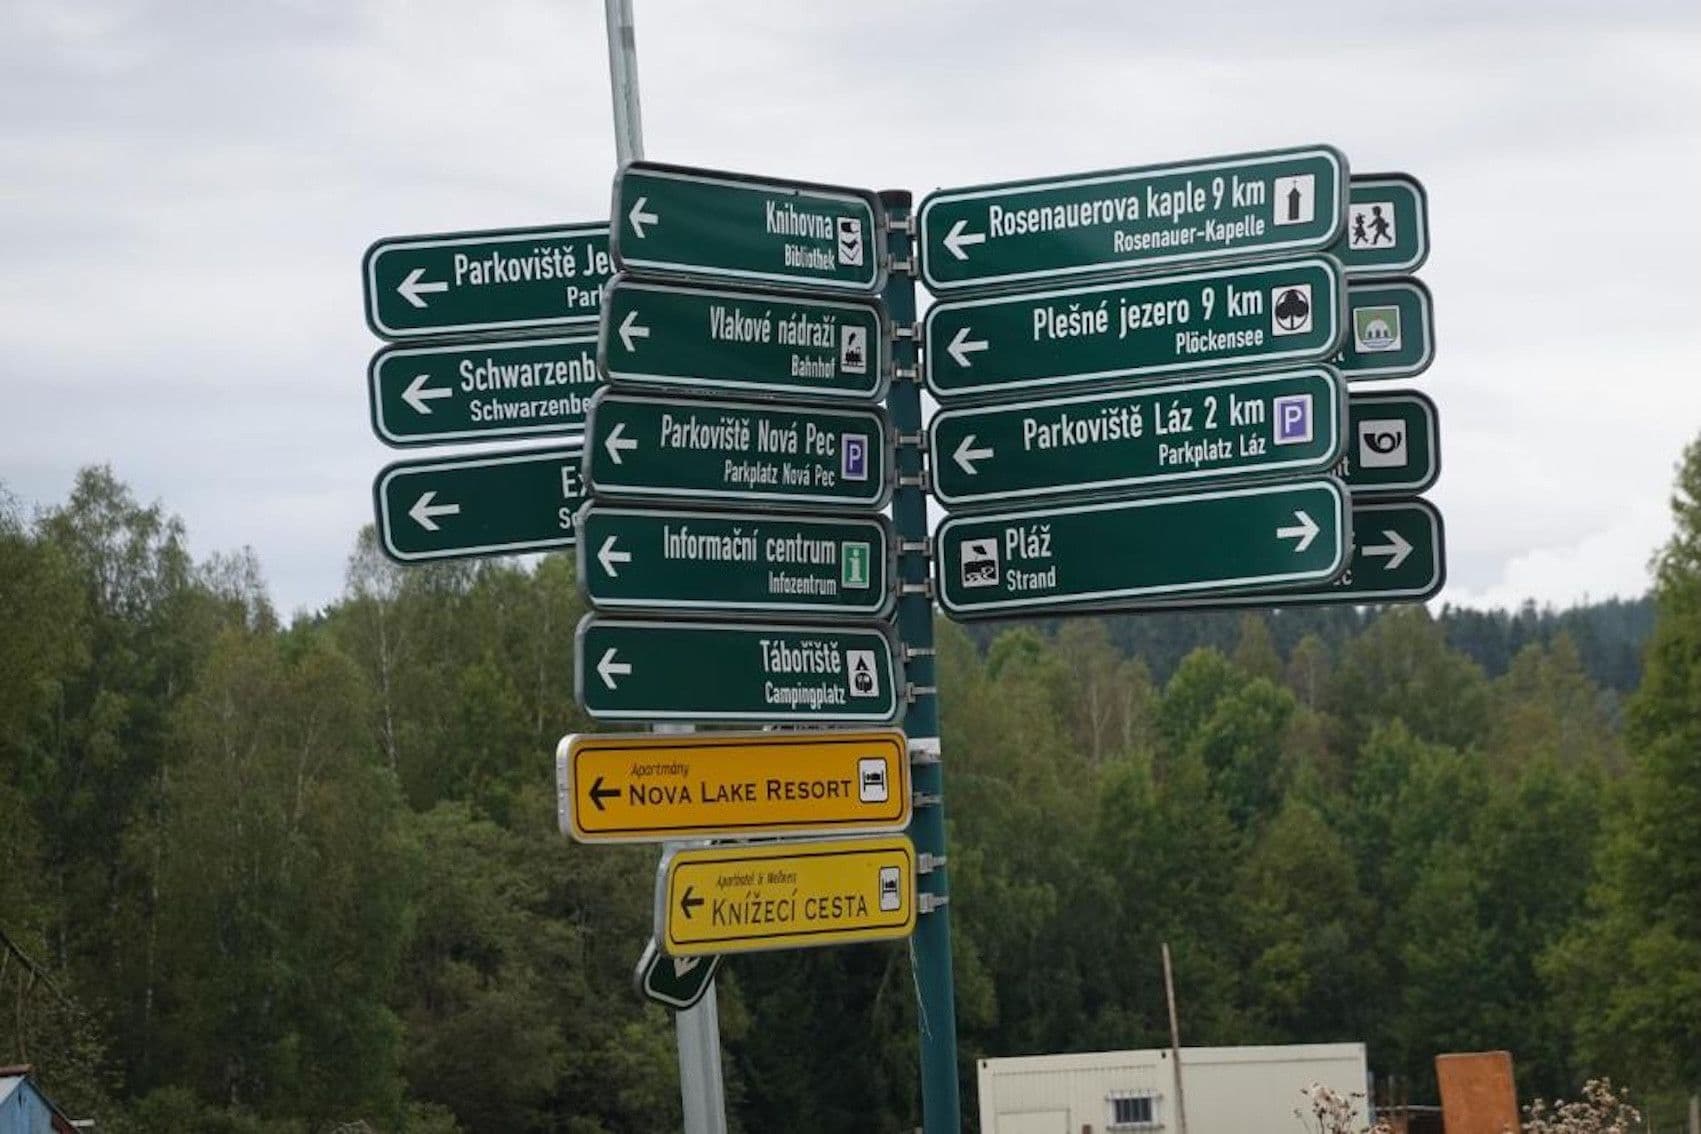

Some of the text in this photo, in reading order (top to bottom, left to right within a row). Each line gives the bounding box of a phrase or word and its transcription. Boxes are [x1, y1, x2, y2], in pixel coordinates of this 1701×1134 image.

[766, 200, 834, 240] Knihovna
[989, 175, 1265, 238] Rosenauerova kaple 9 km
[1114, 215, 1265, 253] Rosenauer-Kapelle
[454, 245, 576, 286] Parkoviště
[784, 244, 836, 270] Bibliothek
[710, 305, 836, 348] Vlakové nádraží
[1033, 284, 1263, 341] Plešné jezero 9 km
[1175, 328, 1264, 355] Plöckensee
[791, 354, 835, 379] Bahnhof
[660, 414, 835, 457] Parkoviště Nová Pec
[1023, 394, 1265, 450] Parkoviště Láz 2 km
[1159, 432, 1266, 468] Parkplatz Láz
[724, 459, 836, 488] Parkplatz Nová Pec
[663, 525, 836, 565] Informační centrum
[1005, 524, 1052, 561] Pláž
[768, 571, 837, 596] Infozentrum
[1006, 565, 1057, 592] Strand
[759, 639, 841, 674] Táboříště
[765, 681, 847, 710] Campingplatz
[711, 888, 869, 927] KNÍŽECÍ CESTA
